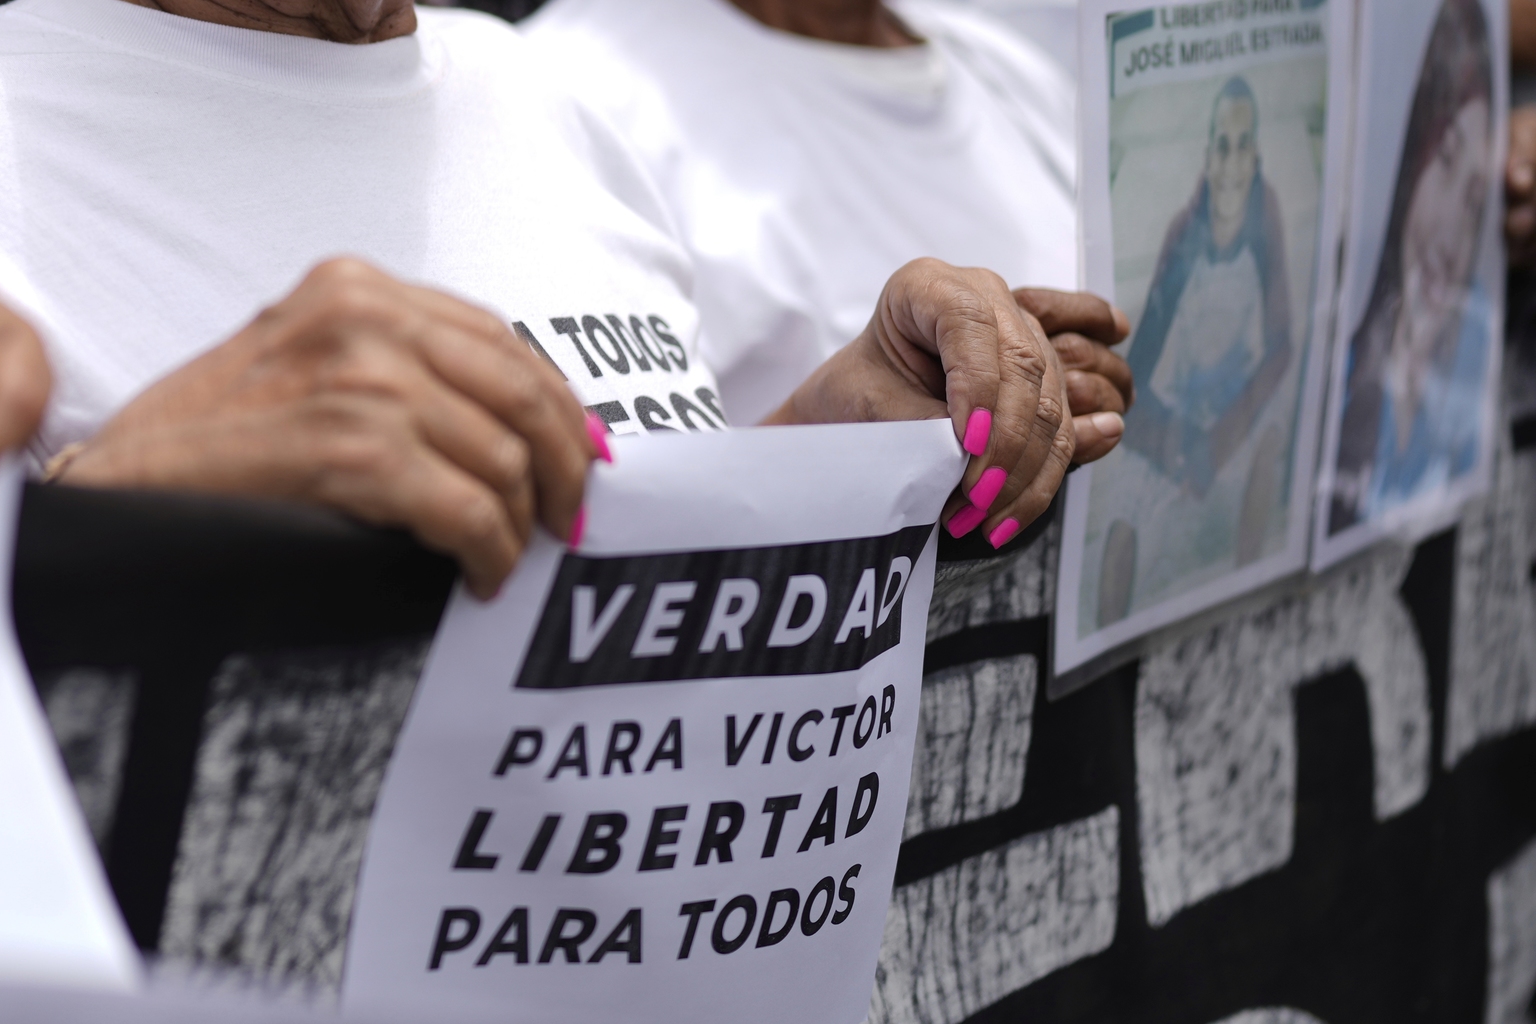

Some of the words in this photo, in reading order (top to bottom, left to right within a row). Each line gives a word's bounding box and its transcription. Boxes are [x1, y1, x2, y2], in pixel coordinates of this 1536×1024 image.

[1125, 36, 1173, 77] JOSÉ
[549, 314, 688, 378] TODOS
[570, 555, 913, 663] VERDAD
[494, 718, 684, 781] PARA
[725, 684, 896, 766] VICTOR
[453, 771, 880, 874] LIBERTAD
[427, 907, 643, 971] PARA
[677, 863, 862, 960] TODOS
